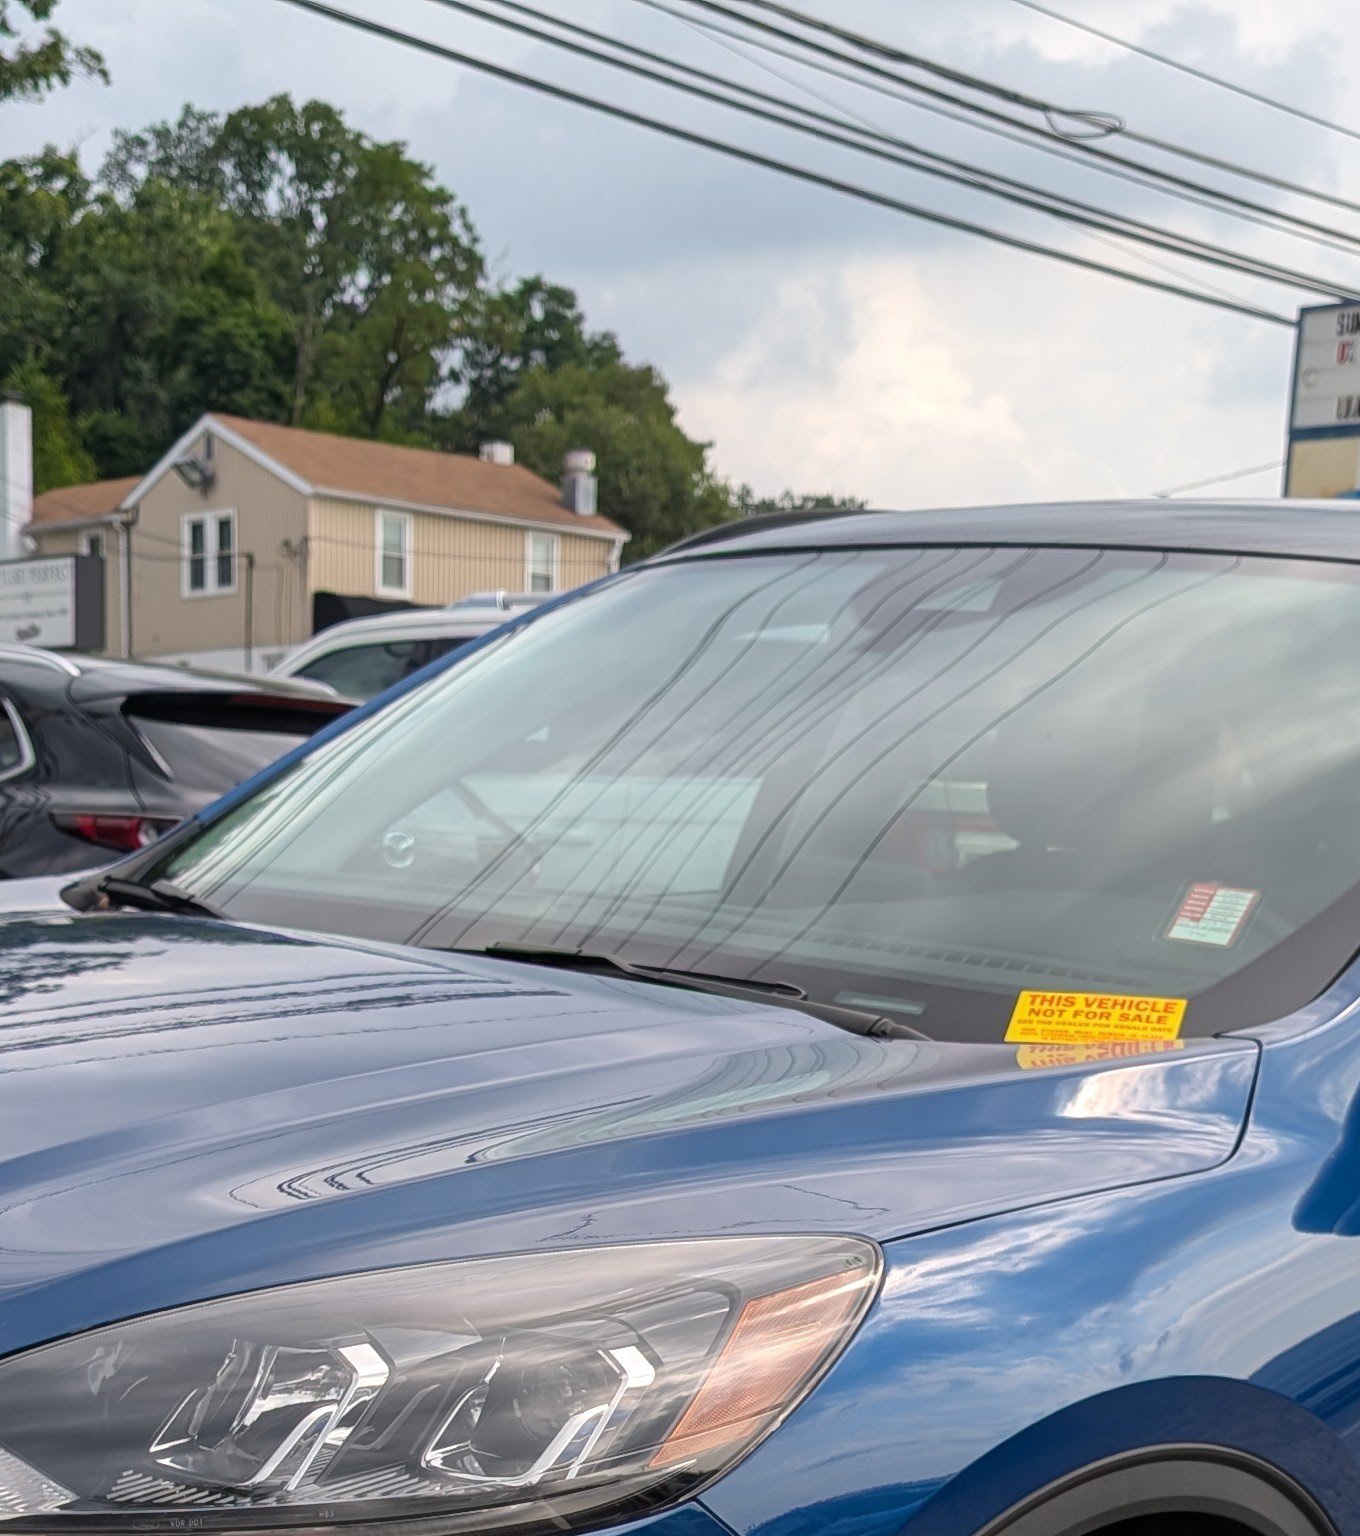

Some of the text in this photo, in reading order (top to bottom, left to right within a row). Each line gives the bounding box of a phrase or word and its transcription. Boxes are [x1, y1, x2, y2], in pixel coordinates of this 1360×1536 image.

[1028, 994, 1178, 1015] THIS VEHICLE
[1027, 1008, 1169, 1026] NOT FOR SALE
